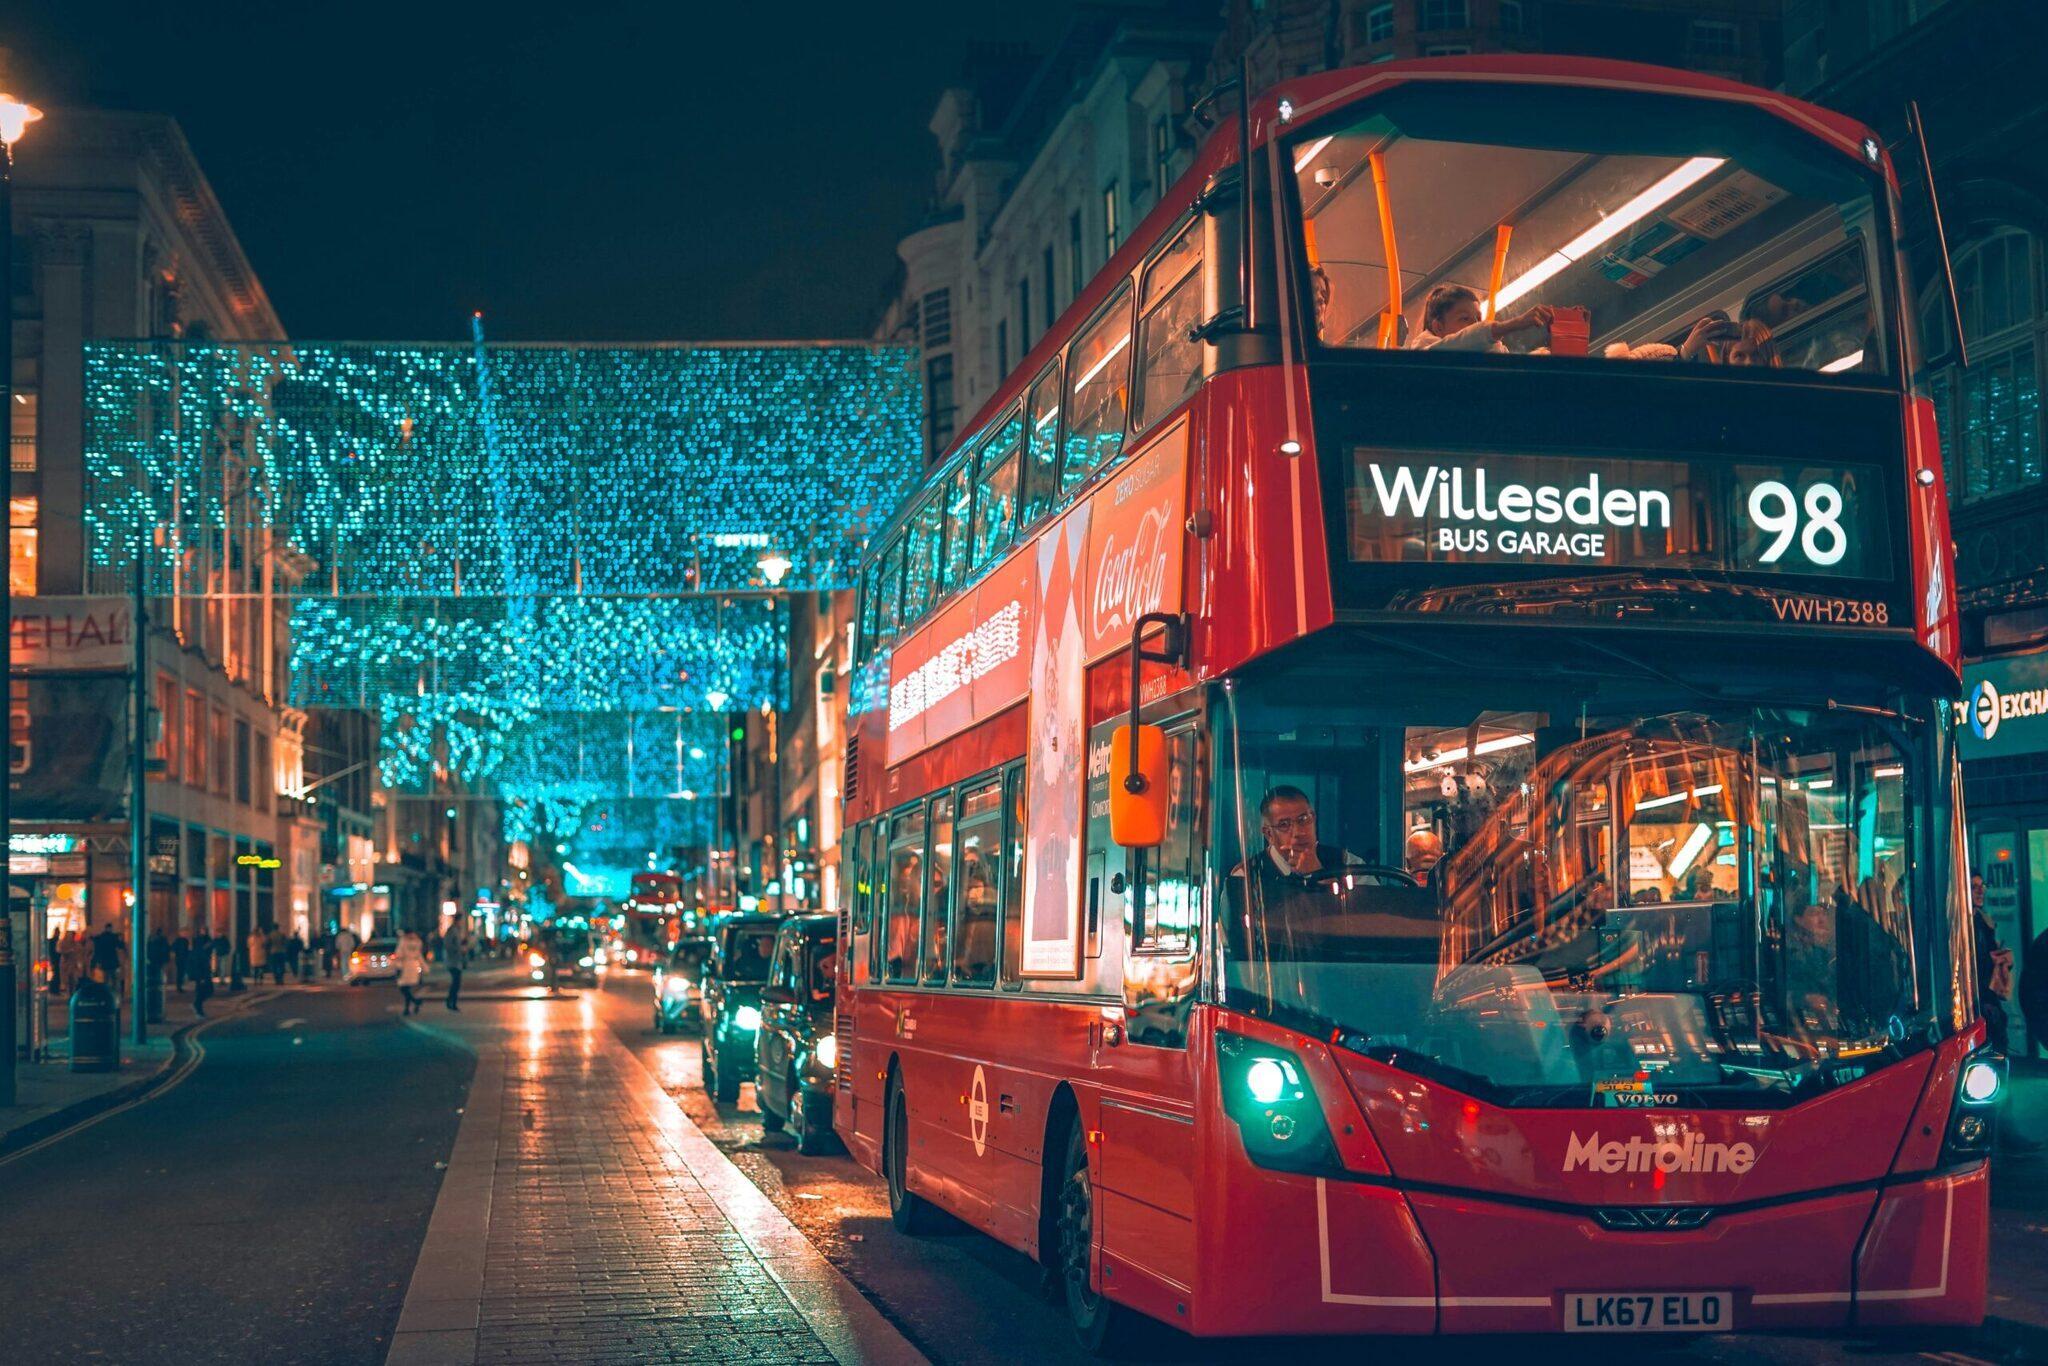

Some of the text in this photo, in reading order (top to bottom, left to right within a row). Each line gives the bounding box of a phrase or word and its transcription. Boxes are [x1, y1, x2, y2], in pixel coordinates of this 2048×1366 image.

[1369, 463, 1848, 566] Willesden 98
[1438, 529, 1606, 558] BUS GARAGE
[1093, 500, 1172, 641] Coca-Cola
[1772, 598, 1889, 625] VWH2388
[1987, 862, 2015, 888] ATM
[1616, 1093, 1679, 1105] VOLVO
[1562, 1129, 1756, 1174] Metroline
[1576, 1296, 1654, 1327] LK67
